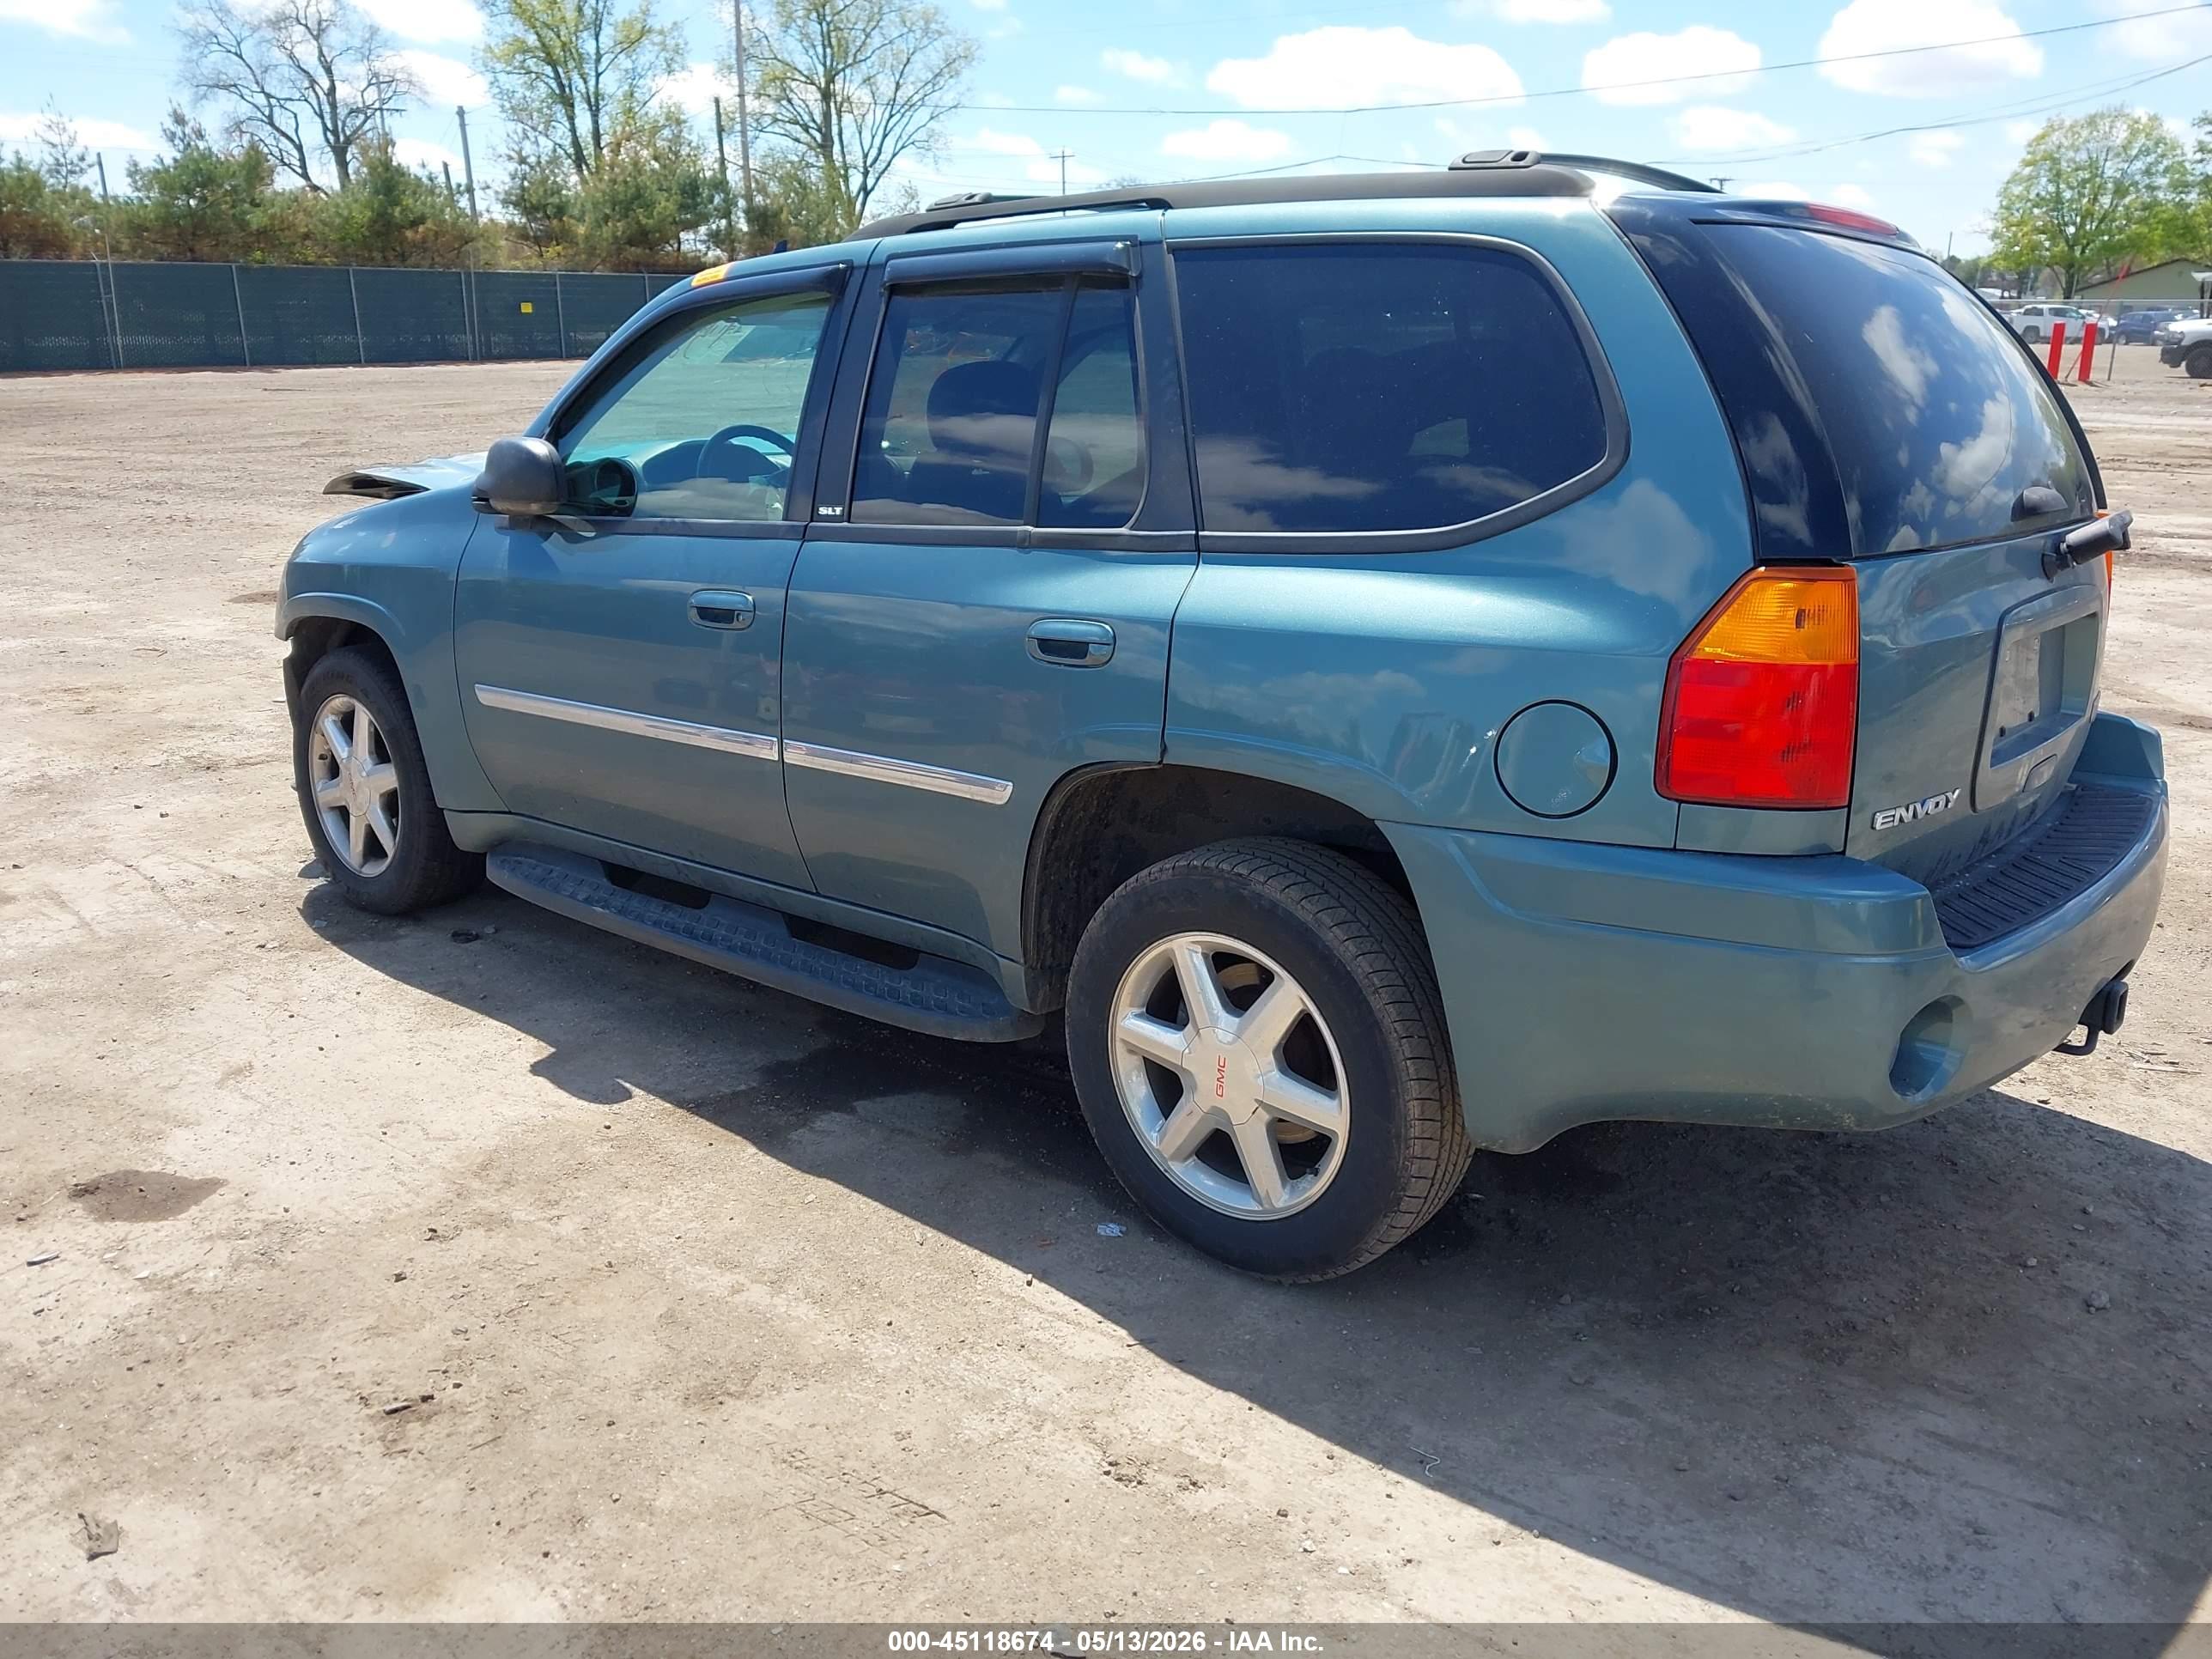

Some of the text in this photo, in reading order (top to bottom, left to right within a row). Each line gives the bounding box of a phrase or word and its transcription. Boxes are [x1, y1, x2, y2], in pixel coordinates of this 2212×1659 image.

[817, 507, 843, 515] SLT
[1872, 788, 1961, 830] ENVOY
[1215, 1054, 1226, 1098] GMC
